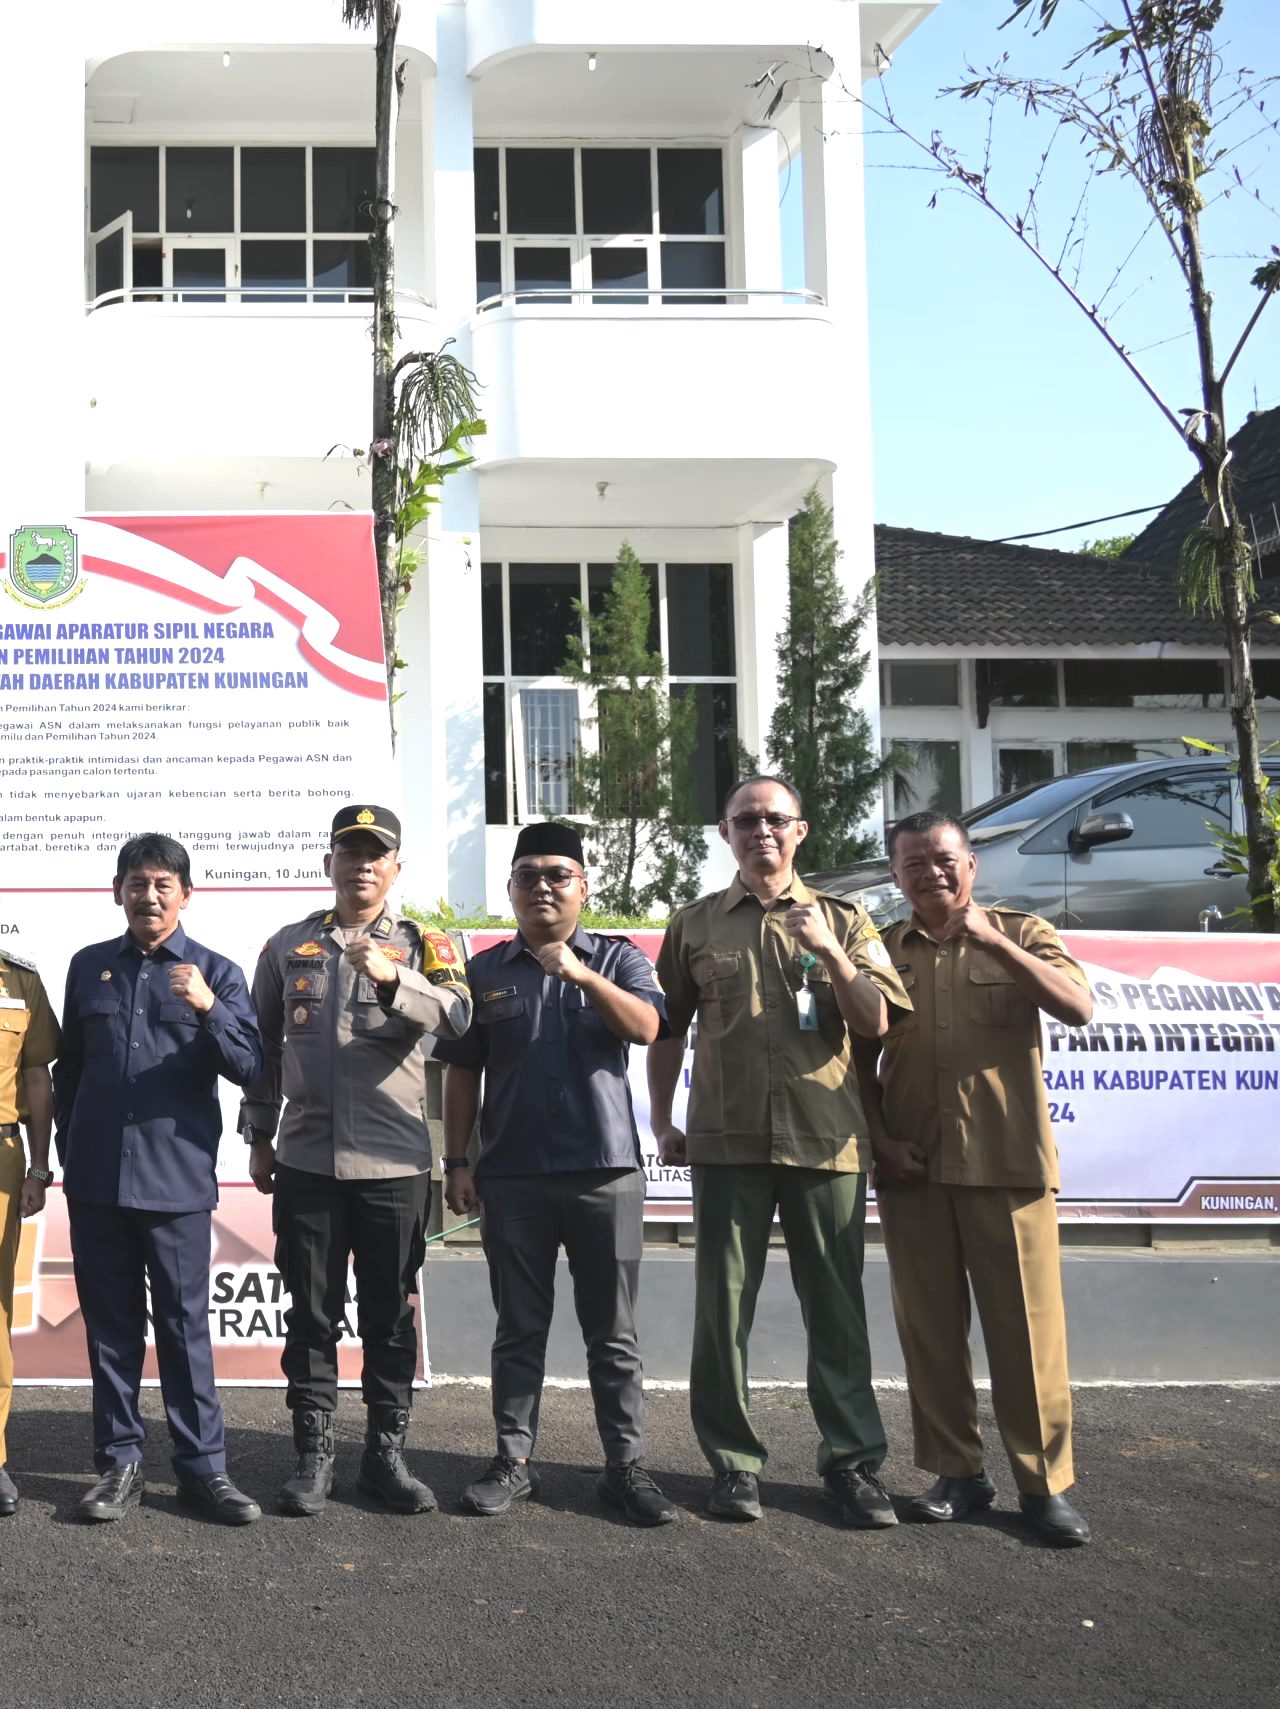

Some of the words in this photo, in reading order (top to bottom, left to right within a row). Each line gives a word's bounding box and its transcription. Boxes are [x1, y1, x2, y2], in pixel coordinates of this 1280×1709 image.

[56, 623, 149, 640] APARATUR
[154, 623, 199, 639] SIPIL
[204, 622, 274, 639] NEGARA
[13, 648, 109, 665] PEMILIHAN
[114, 648, 173, 664] TAHUN
[178, 647, 225, 664] 2024
[29, 673, 99, 690] DAERAH
[105, 672, 209, 689] KABUPATEN
[214, 672, 308, 689] KUNINGAN
[5, 704, 57, 712] Pemilihan
[59, 704, 91, 712] Tahun
[93, 704, 117, 712] 2024
[39, 721, 62, 729] ASN
[68, 721, 100, 729] dalam
[107, 721, 182, 729] melaksanakan
[188, 721, 221, 730] fungsi
[228, 721, 282, 730] pelayanan
[288, 720, 320, 729] publik
[46, 732, 97, 740] Pemilihan
[99, 732, 130, 740] Tahun
[132, 732, 158, 740] 2024.
[9, 756, 84, 766] praktik-praktik
[88, 756, 139, 764] intimidasi
[142, 756, 162, 764] dan
[217, 755, 255, 764] kepada
[258, 754, 303, 764] Pegawai
[306, 754, 329, 762] ASN
[332, 754, 352, 762] dan
[29, 769, 81, 777] pasangan
[82, 767, 111, 775] calon
[113, 767, 157, 775] tertentu.
[10, 790, 37, 798] tidak
[44, 790, 120, 800] menyebarkan
[127, 790, 162, 800] ujaran
[169, 790, 226, 798] kebencian
[268, 789, 301, 797] berita
[308, 789, 353, 798] bohong.
[25, 814, 61, 822] bentuk
[63, 815, 106, 823] apapun.
[2, 831, 44, 841] dengan
[50, 831, 85, 841] penuh
[178, 831, 232, 841] tanggung
[238, 830, 271, 841] jawab
[278, 830, 311, 838] dalam
[45, 843, 90, 851] beretika
[96, 843, 116, 851] dan
[192, 842, 219, 850] demi
[226, 842, 294, 852] terwujudnya
[301, 843, 331, 852] persa
[205, 868, 271, 882] Kuningan,
[276, 868, 290, 879] 10
[294, 868, 322, 879] Juni
[1121, 983, 1263, 1012] PEGAWAI
[1046, 1021, 1147, 1052] PAKTA
[1042, 1069, 1084, 1090] RAH
[1093, 1070, 1227, 1090] KABUPATEN
[1236, 1070, 1280, 1090] KUN
[1201, 1196, 1279, 1212] KUNINGAN,
